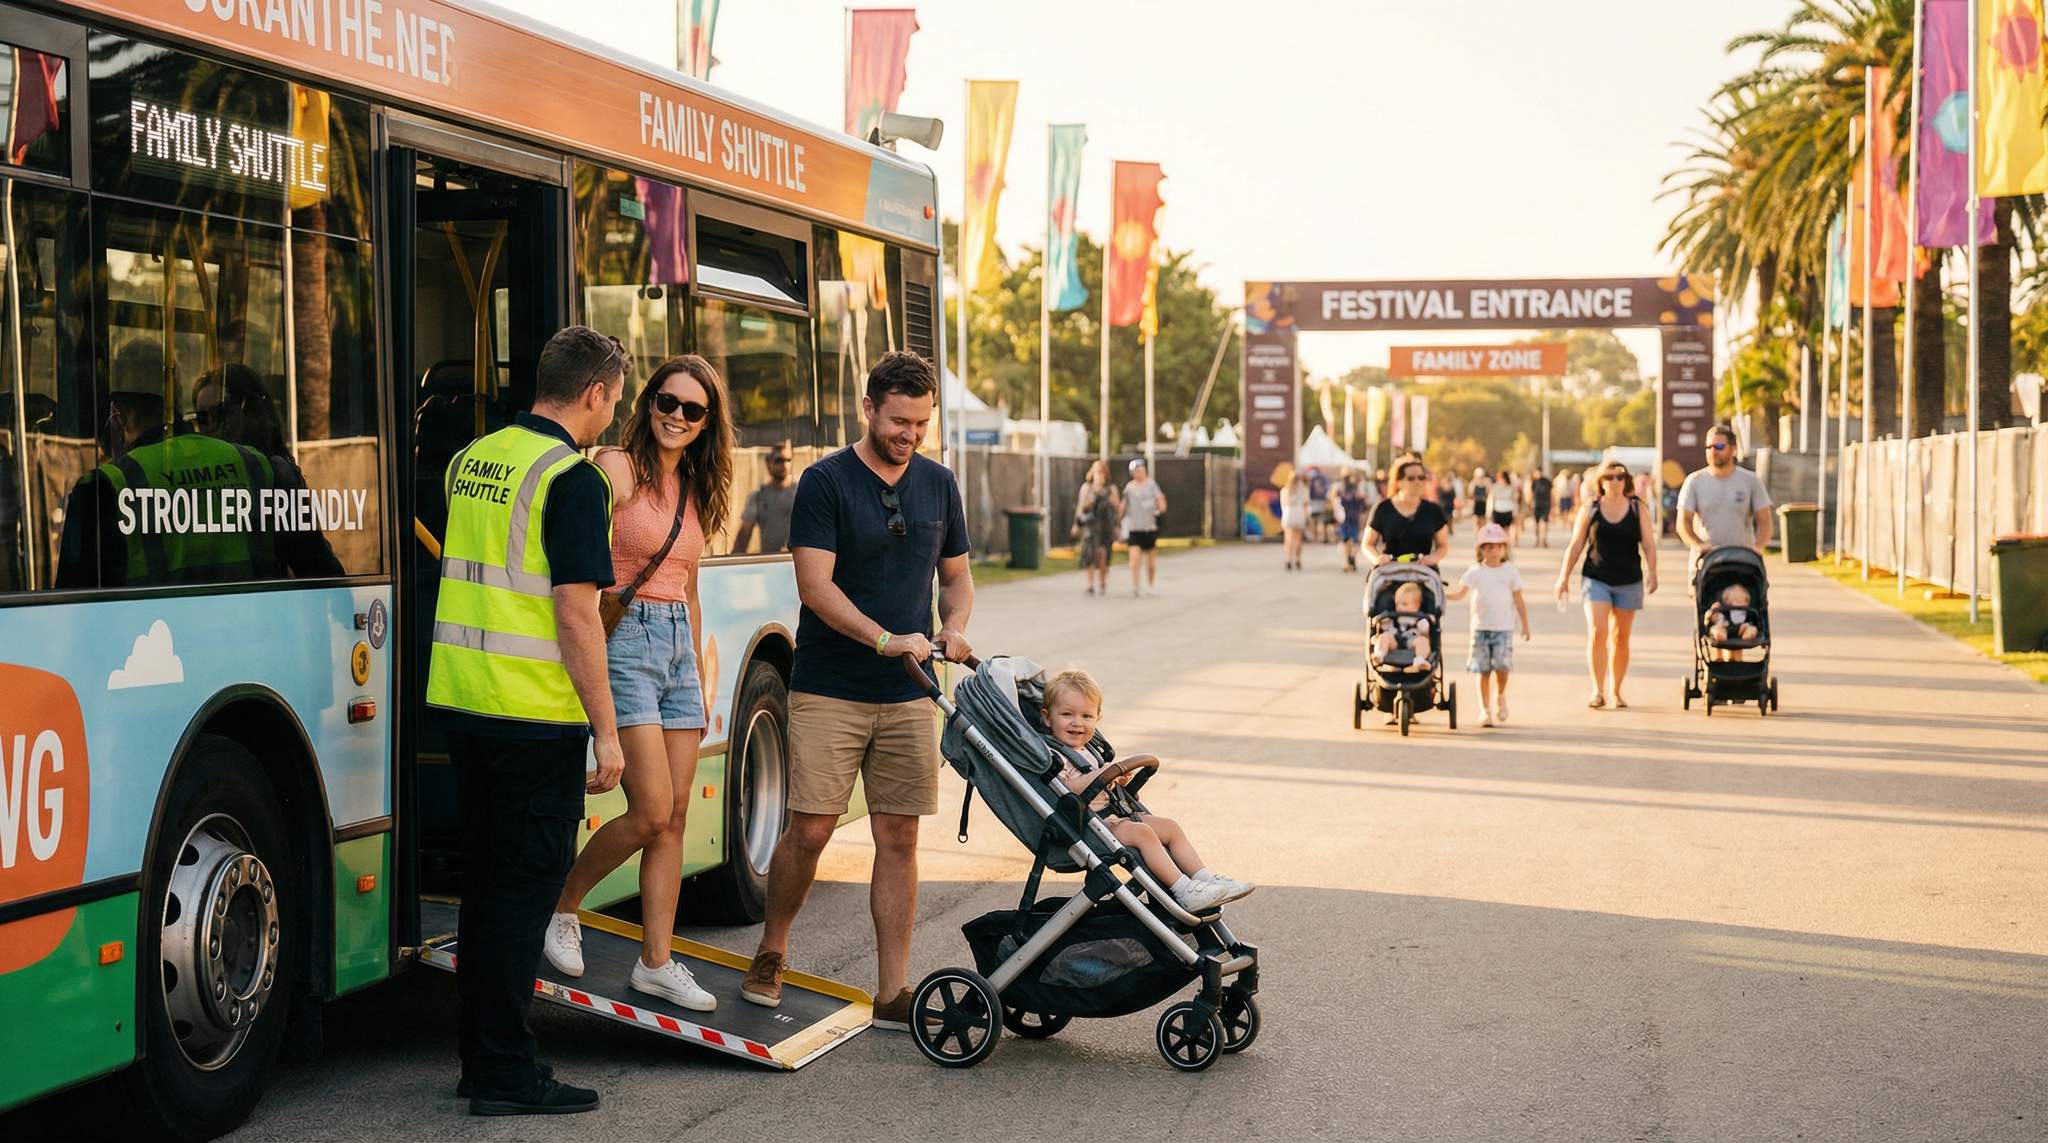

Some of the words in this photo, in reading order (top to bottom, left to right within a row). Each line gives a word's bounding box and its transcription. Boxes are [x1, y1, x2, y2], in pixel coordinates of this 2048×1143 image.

[184, 0, 457, 88] ANTHE.NE
[131, 100, 222, 169] FAMILY
[228, 123, 327, 192] SHUTTLE
[639, 90, 715, 165] FAMILY
[720, 118, 807, 193] SHUTTLE
[1321, 289, 1464, 320] FESTIVAL
[1470, 287, 1633, 319] ENTRANCE
[1412, 350, 1484, 371] FAMILY
[1488, 349, 1541, 371] ZONE
[462, 458, 516, 482] FAMILY
[118, 487, 252, 536] STROLLER
[260, 488, 368, 533] FRIENDLY
[452, 478, 511, 505] SHUTTLE
